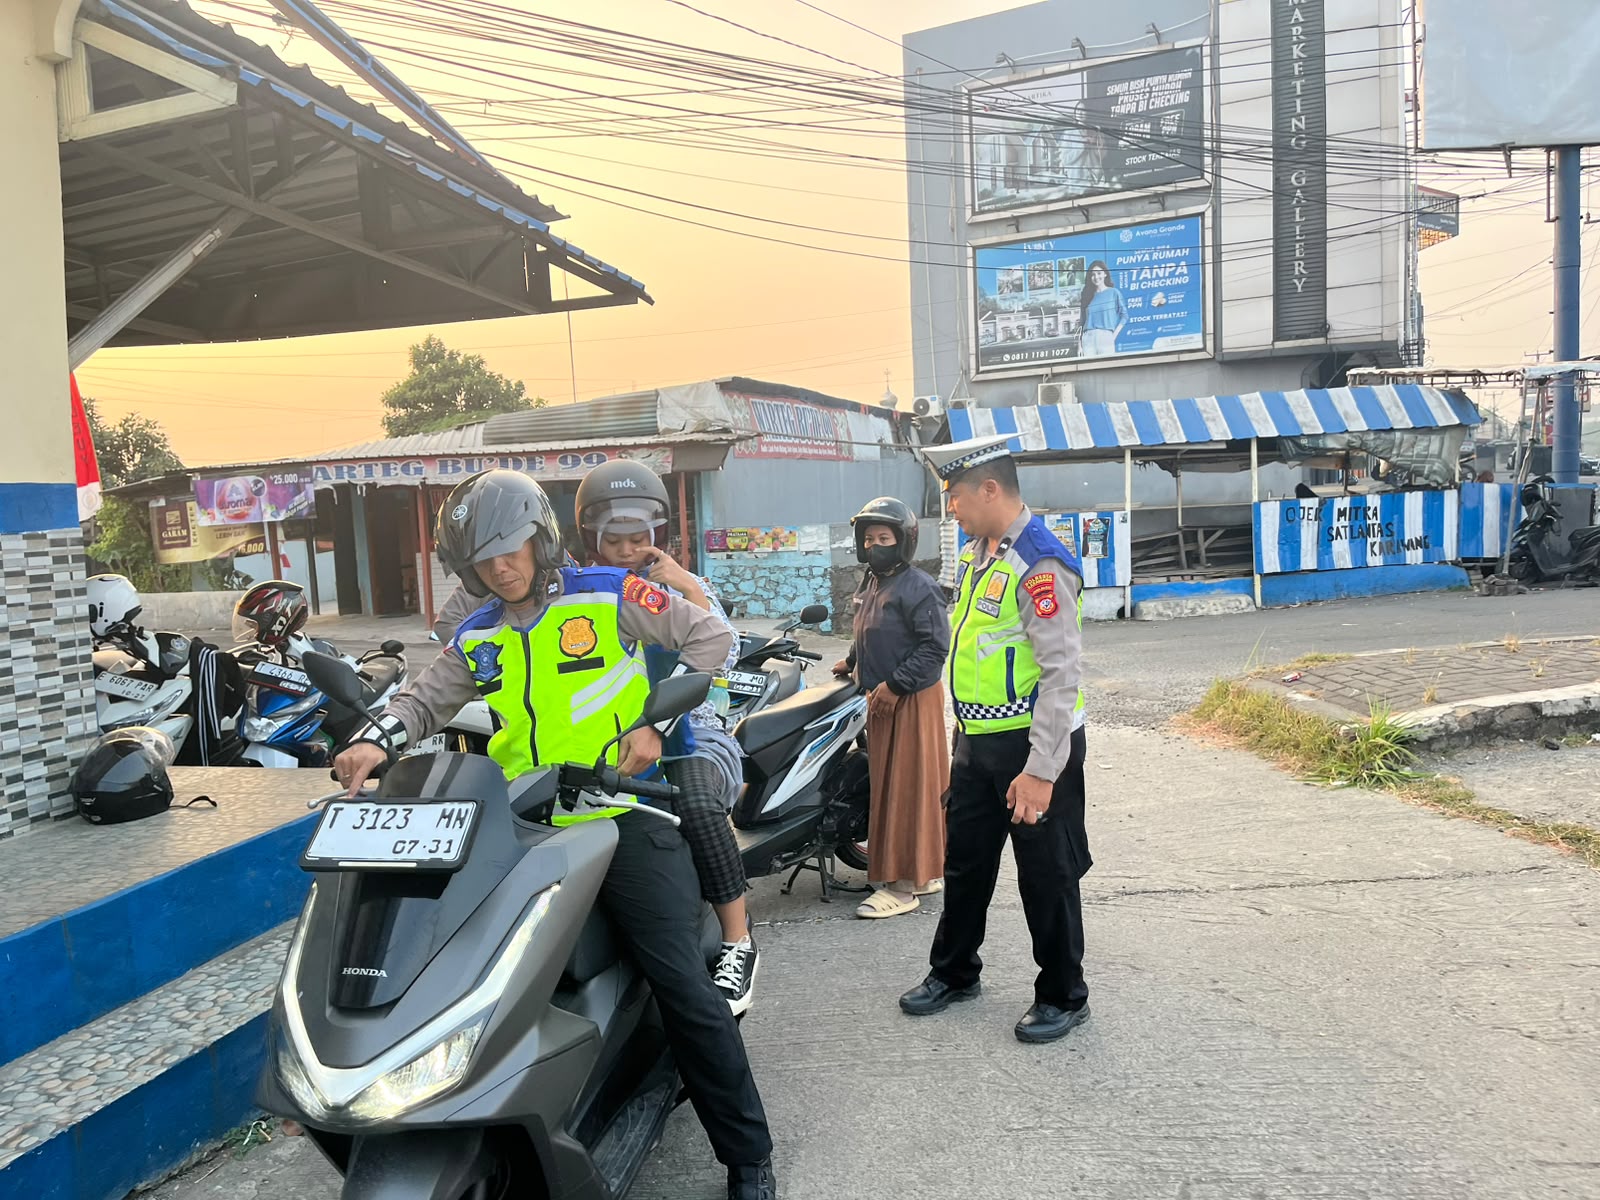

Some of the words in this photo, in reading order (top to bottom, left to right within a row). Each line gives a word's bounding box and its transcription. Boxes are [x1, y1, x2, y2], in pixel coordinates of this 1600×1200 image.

[1110, 102, 1137, 117] TANPA
[1138, 99, 1148, 112] BI
[1149, 91, 1190, 110] CHECKING
[1125, 155, 1148, 166] STOCK
[1135, 229, 1158, 237] Avana
[1159, 224, 1185, 233] Grande
[1290, 170, 1309, 293] GALLERY
[1116, 253, 1150, 266] PUNYA
[1152, 247, 1190, 261] RUMAH
[1130, 260, 1188, 281] TANPA
[1129, 282, 1140, 291] BI
[1140, 275, 1190, 289] CHECKING
[1129, 315, 1151, 323] STOCK
[1011, 353, 1029, 361] 0811
[1031, 350, 1049, 359] 1181
[1051, 348, 1070, 356] 1077
[312, 459, 425, 481] ARTEG
[436, 454, 545, 475] BU'DE
[557, 451, 609, 470] 99
[610, 478, 636, 489] mds
[1285, 506, 1324, 523] OJEK
[1337, 506, 1378, 521] MITRA
[1327, 522, 1395, 542] SATLANTAS
[259, 663, 266, 672] T
[109, 676, 134, 687] 6067
[431, 736, 444, 746] RK
[328, 807, 344, 829] T
[352, 808, 414, 830] 3123
[436, 808, 469, 829] MN
[341, 967, 389, 977] HONDA
